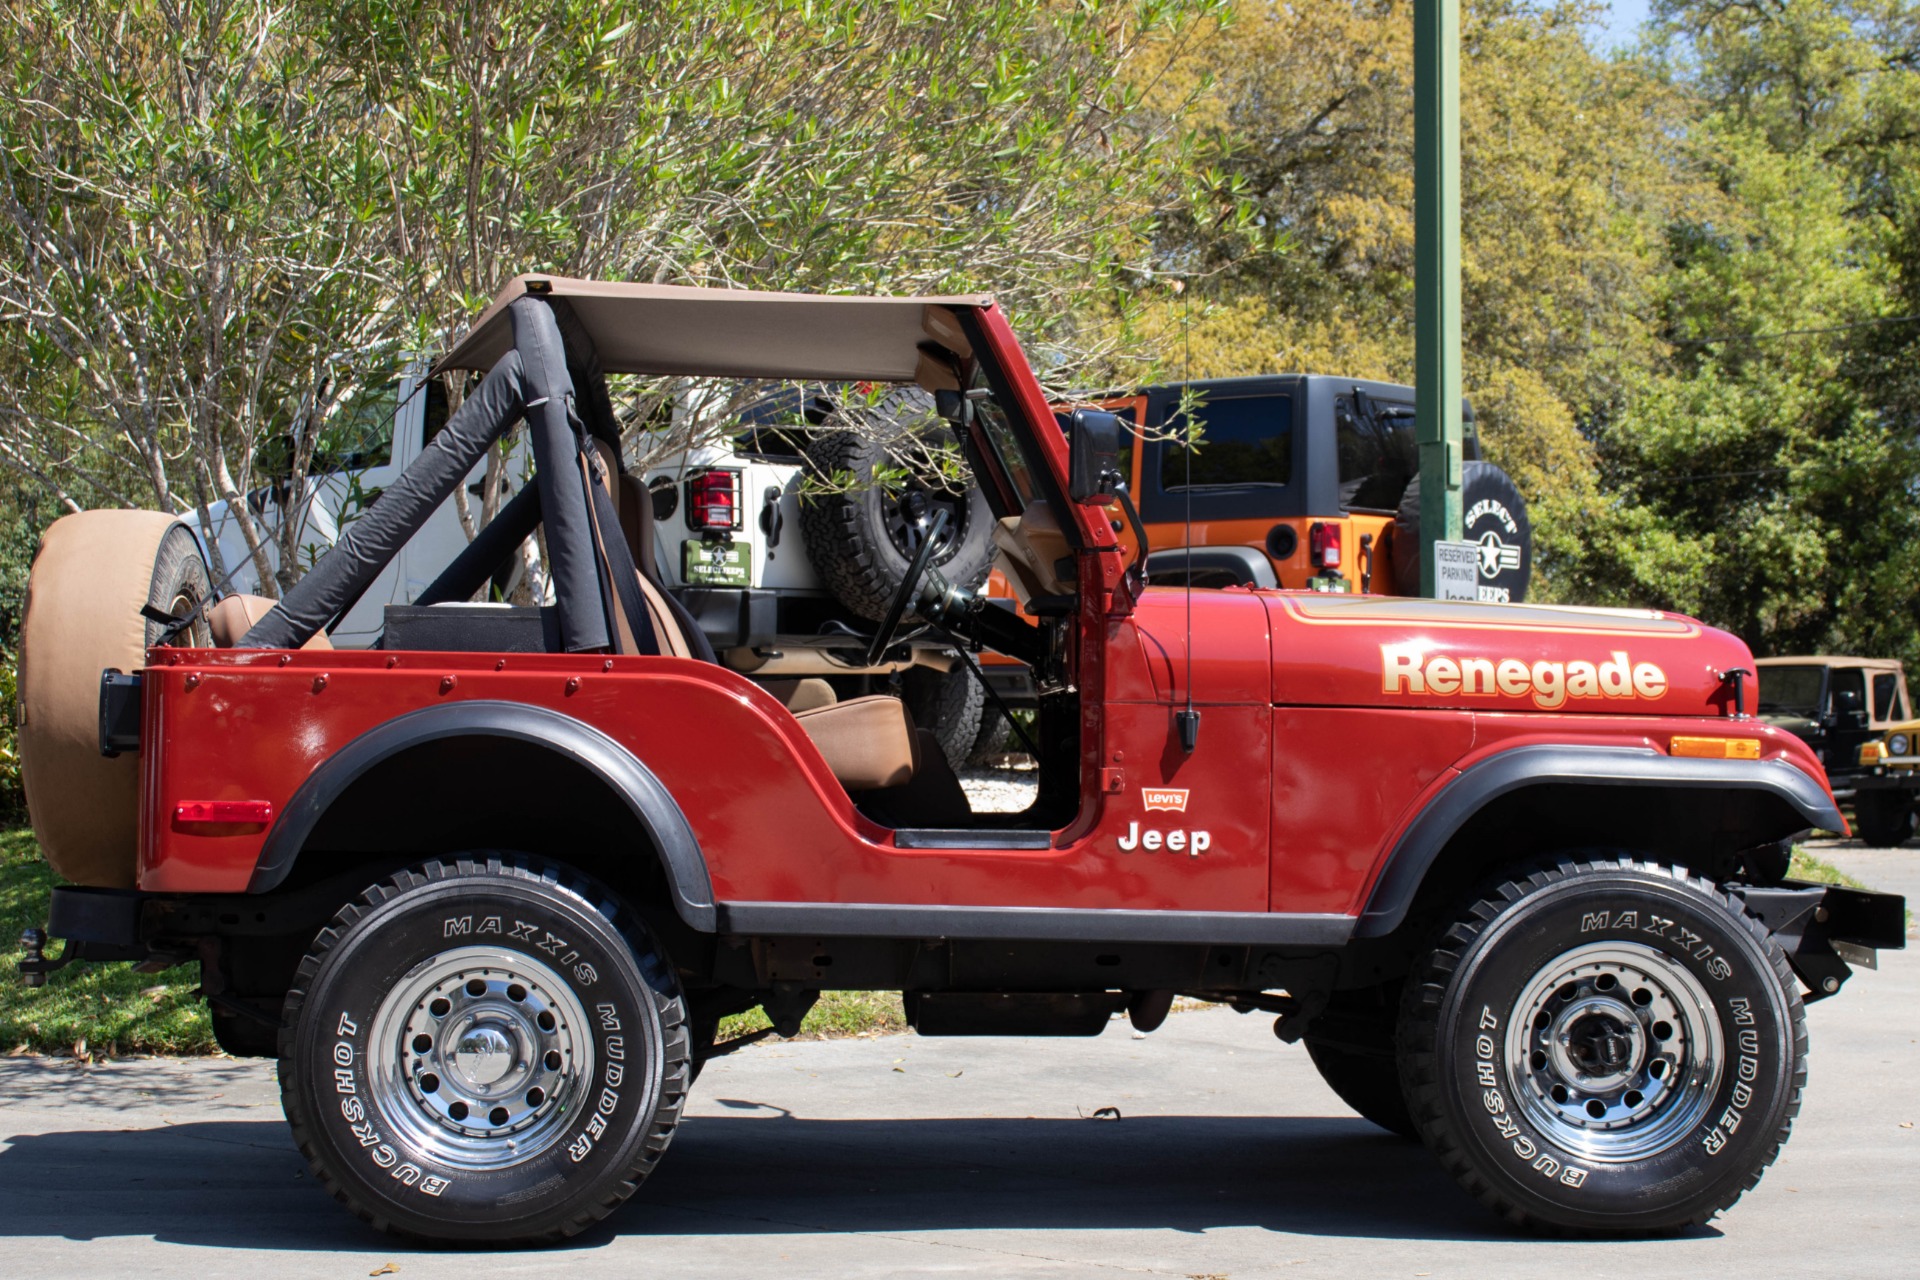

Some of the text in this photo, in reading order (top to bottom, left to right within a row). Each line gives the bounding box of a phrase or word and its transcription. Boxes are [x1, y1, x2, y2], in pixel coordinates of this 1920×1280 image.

[1465, 500, 1518, 534] SELECT
[1438, 548, 1475, 564] RESERVED
[1441, 566, 1474, 582] PARKING
[1478, 585, 1510, 603] EEPS
[1380, 643, 1669, 709] Renegade
[1118, 821, 1211, 855] Jeep
[443, 915, 599, 987] MAXXIS
[1580, 910, 1733, 981] MAXXIS
[333, 1011, 451, 1197] BUCKSHOT
[568, 1003, 625, 1163] MUDDER
[1476, 1005, 1589, 1189] BUCKSHOT
[1702, 997, 1758, 1156] MUDDER
